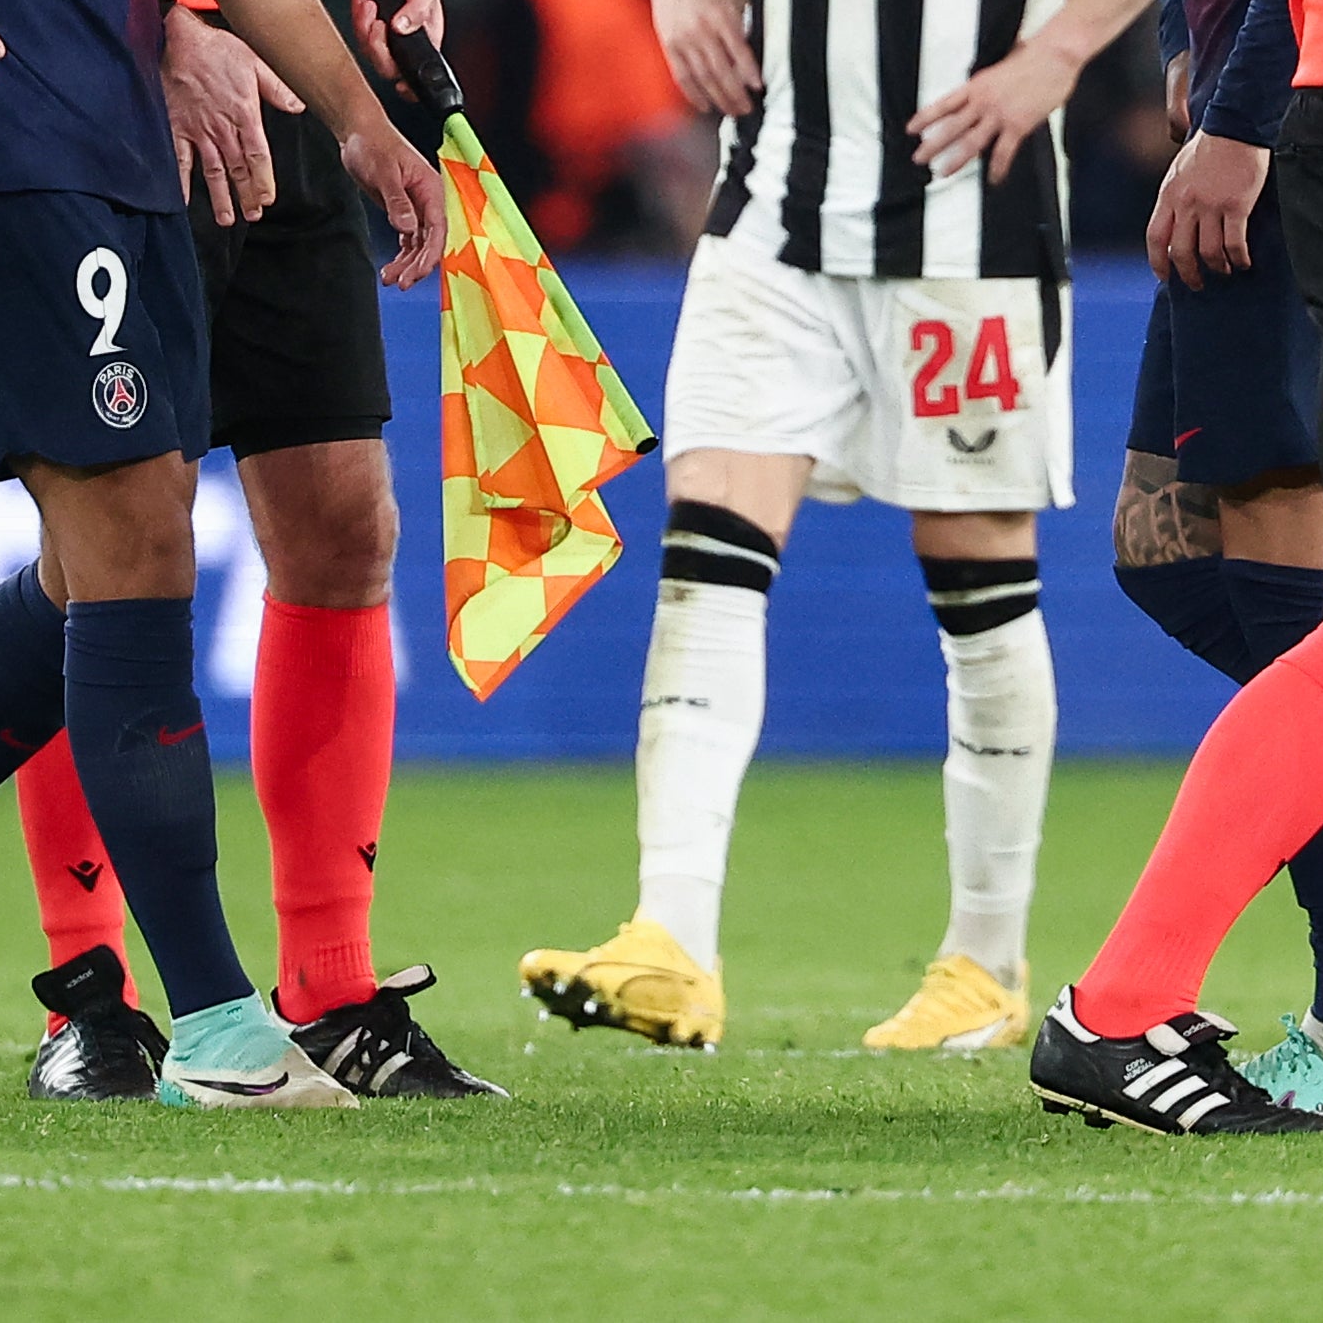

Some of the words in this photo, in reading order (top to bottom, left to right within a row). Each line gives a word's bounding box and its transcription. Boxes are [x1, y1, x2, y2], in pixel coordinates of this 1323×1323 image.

[76, 246, 128, 357] 9
[99, 364, 135, 385] PARIS
[911, 315, 1020, 418] 24
[1125, 1057, 1146, 1072] COPA
